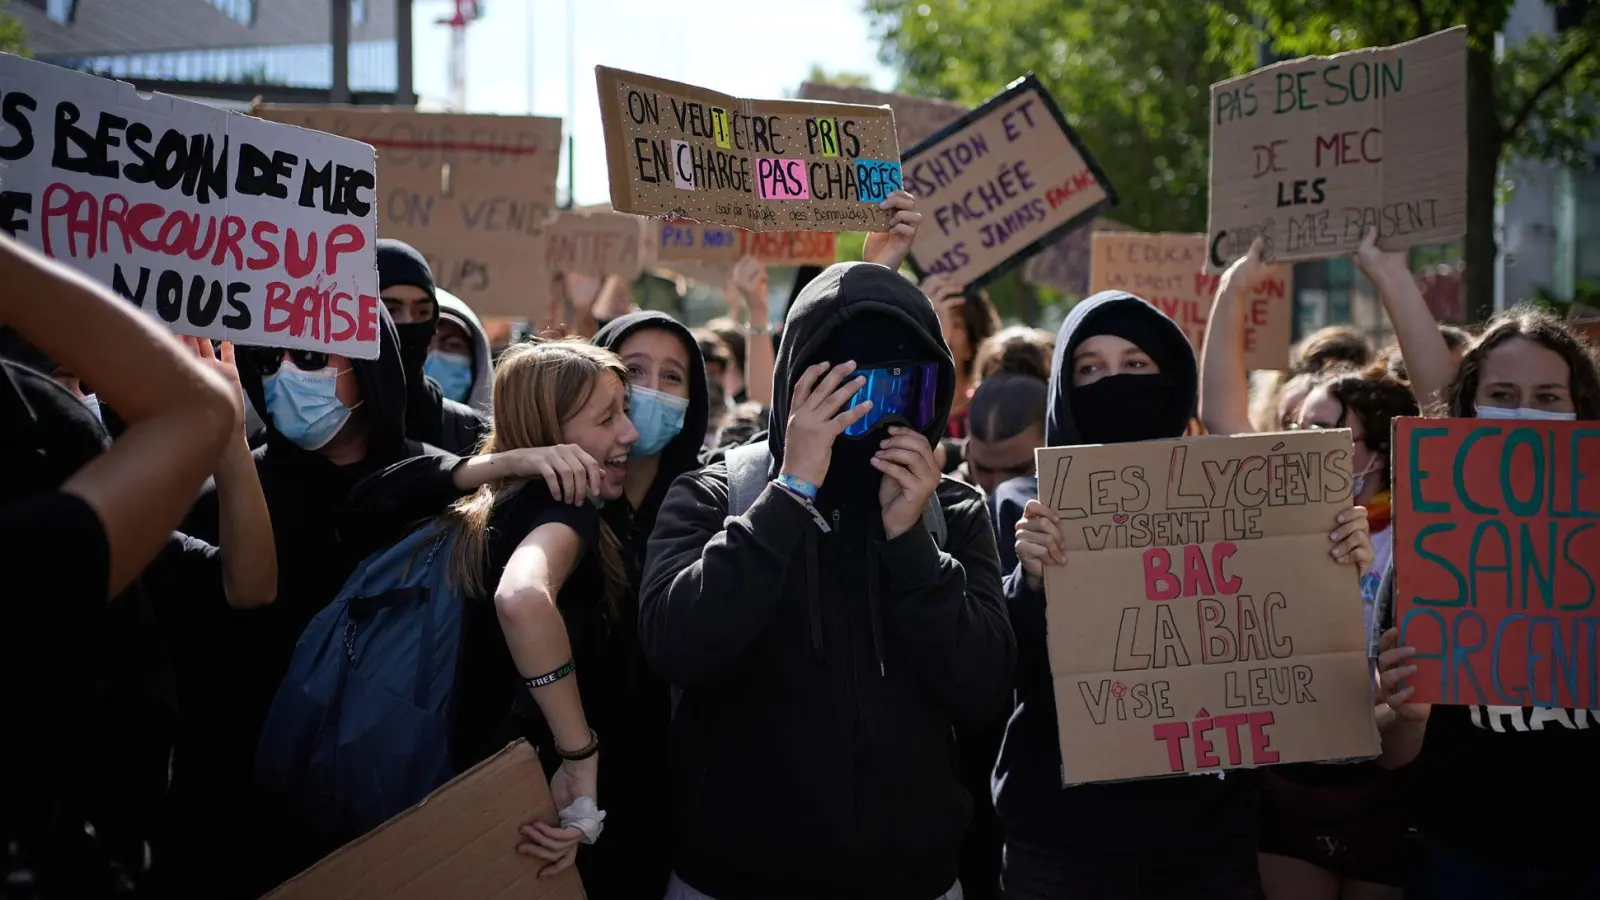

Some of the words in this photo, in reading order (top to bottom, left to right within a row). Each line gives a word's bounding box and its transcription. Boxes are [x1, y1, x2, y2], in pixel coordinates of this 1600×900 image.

[1216, 83, 1259, 126] PAS
[1273, 57, 1404, 116] BESOIN
[627, 90, 660, 125] ON
[671, 97, 726, 142] VEUT
[806, 117, 861, 158] PRIS
[903, 131, 990, 199] ASHION
[1001, 100, 1037, 143] ET
[1252, 139, 1289, 179] DE
[1315, 128, 1383, 169] MEC
[52, 101, 229, 204] BESOIN
[235, 143, 298, 199] DE
[298, 158, 376, 218] MEC
[634, 138, 669, 183] EN
[676, 143, 752, 193] CHARGE
[758, 159, 804, 198] PAS
[387, 186, 434, 228] ON
[789, 209, 808, 221] des
[1276, 177, 1327, 208] LES
[41, 182, 366, 279] PARCOURSUP
[660, 225, 694, 248] PAS
[978, 197, 1048, 250] JAMAIS
[1286, 209, 1338, 253] ME
[1343, 198, 1440, 244] BAISENT
[113, 262, 252, 330] NOUS
[264, 279, 377, 344] BAISE
[1050, 455, 1152, 520] LES
[1166, 441, 1353, 510] LYCÉENS
[1408, 426, 1600, 519] ECOLE
[1223, 507, 1263, 541] LE
[1142, 541, 1242, 601] BAC
[1411, 519, 1597, 612] SANS
[1113, 603, 1190, 672] LA
[1197, 591, 1293, 666] BAC
[531, 673, 556, 687] FREE
[1224, 664, 1317, 709] LEUR
[1153, 707, 1280, 772] TÊTE
